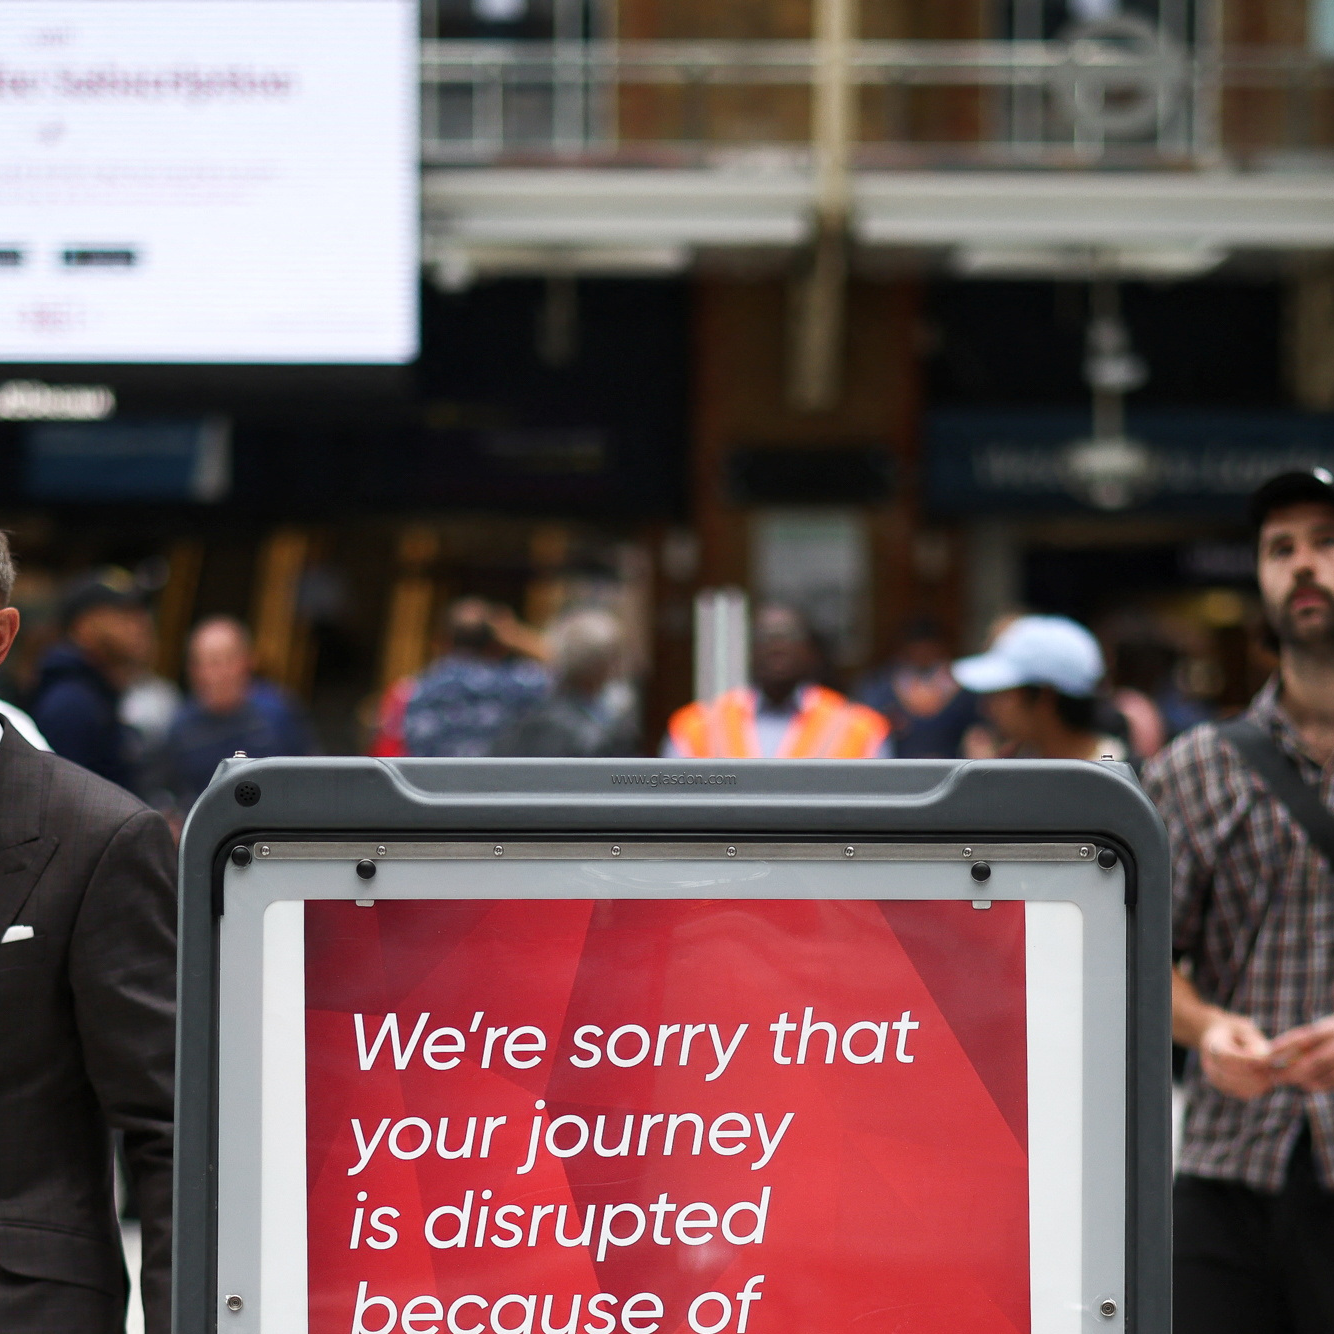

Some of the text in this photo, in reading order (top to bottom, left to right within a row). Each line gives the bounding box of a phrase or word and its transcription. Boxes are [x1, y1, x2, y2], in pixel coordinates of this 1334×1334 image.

[610, 771, 737, 788] www.glasdon.com
[353, 1006, 920, 1082] We're sorry that
[347, 1099, 796, 1176] your journey
[349, 1186, 772, 1262] is disrupted
